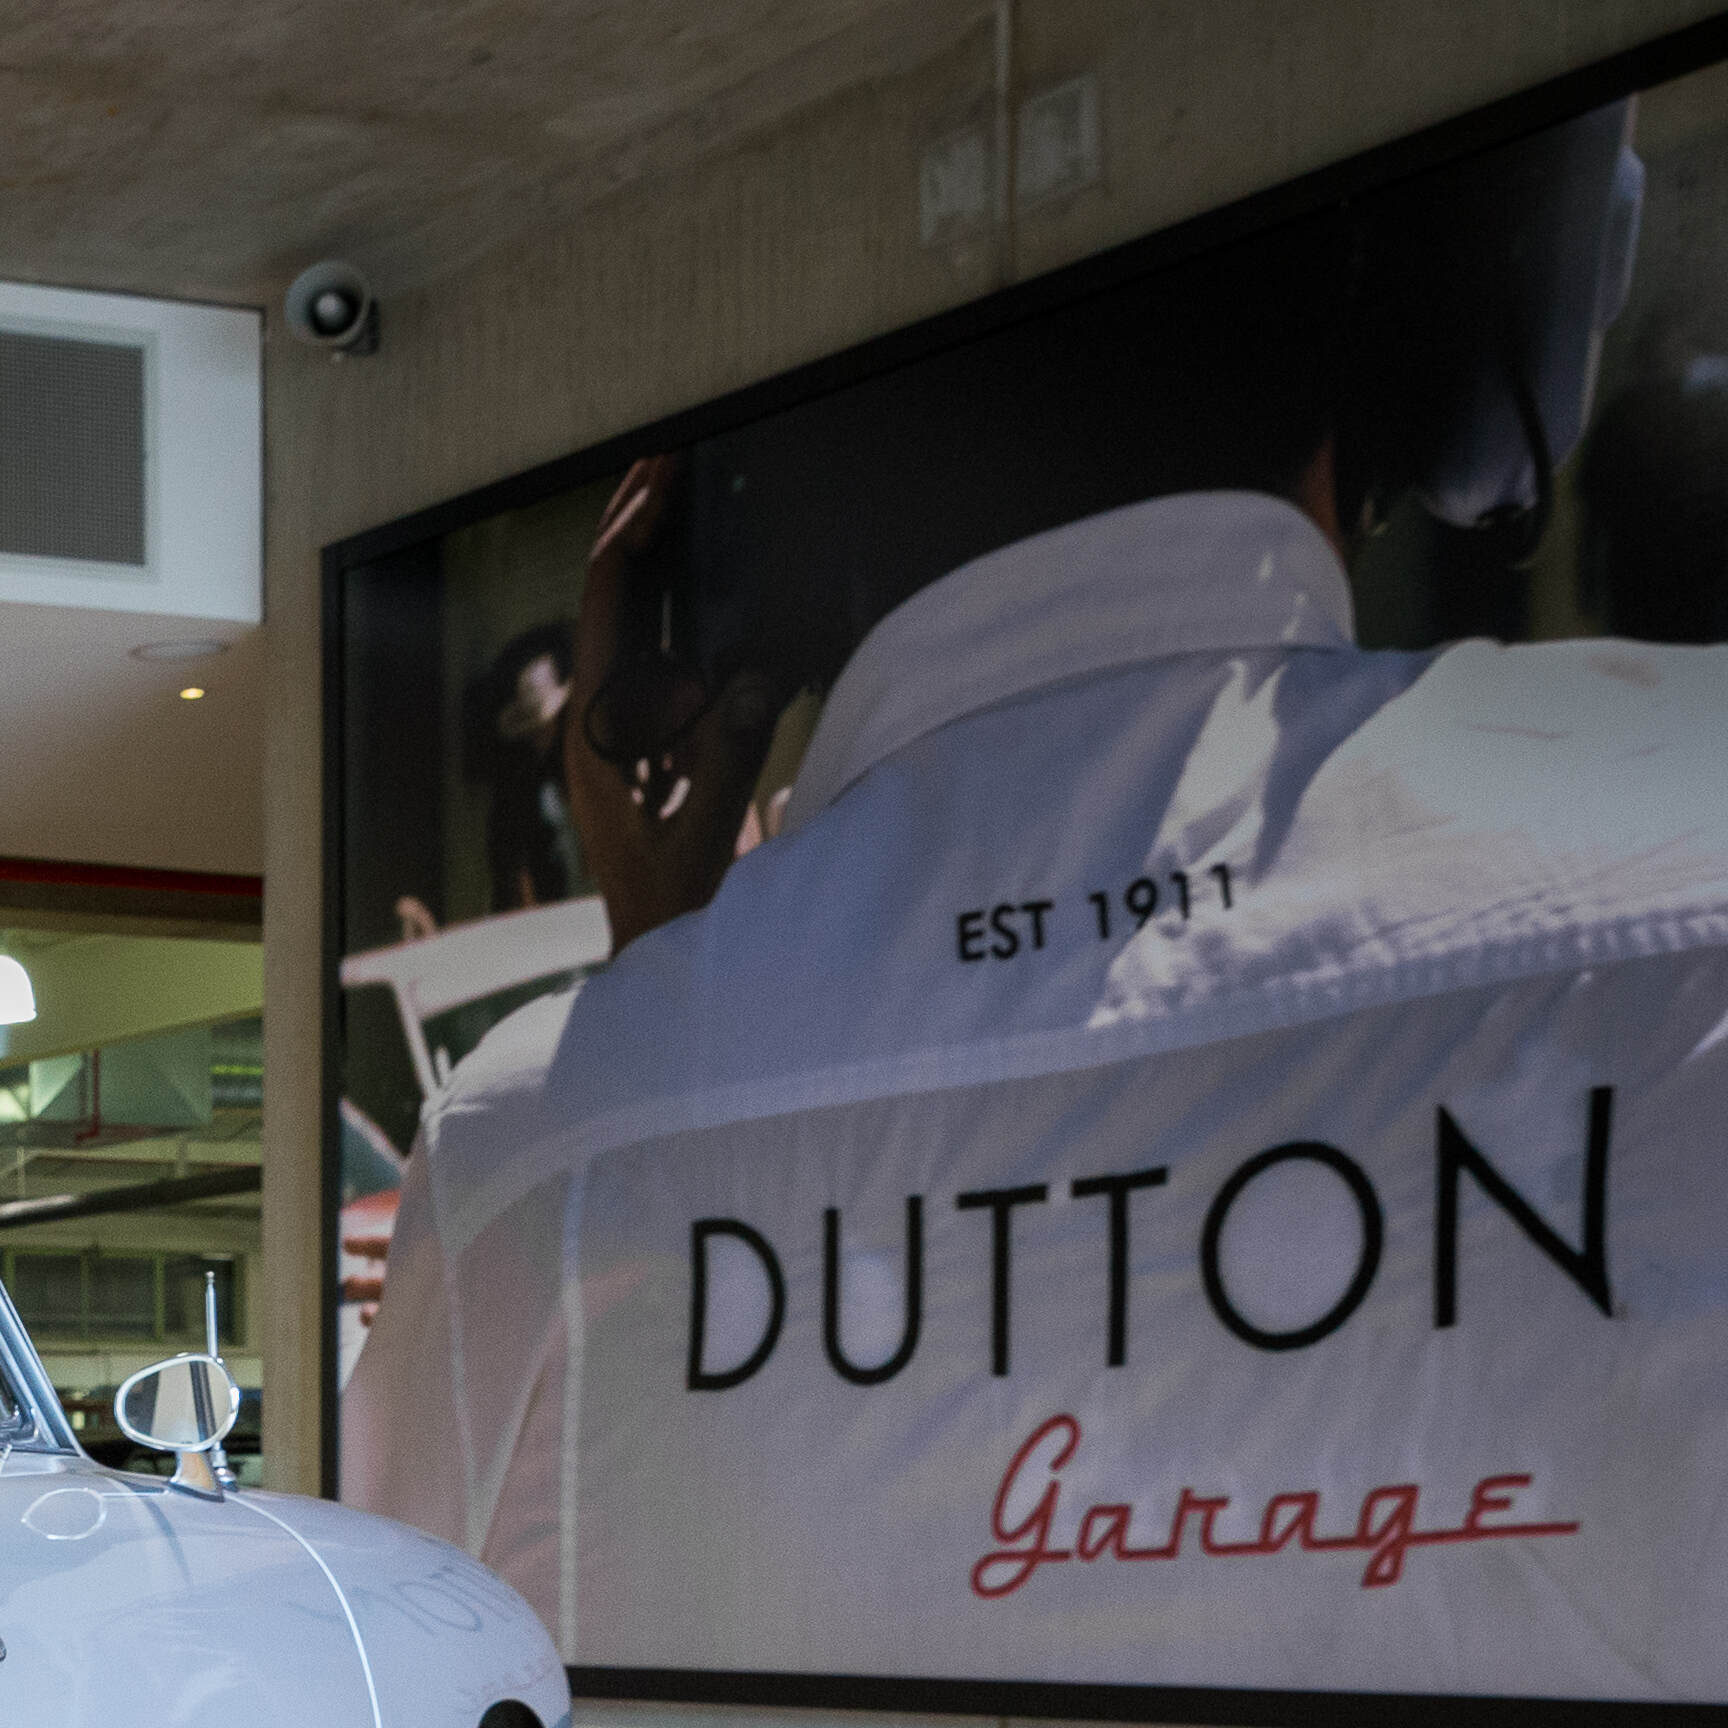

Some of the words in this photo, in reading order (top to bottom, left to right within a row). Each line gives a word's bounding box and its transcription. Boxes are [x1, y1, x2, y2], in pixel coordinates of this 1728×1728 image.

[955, 900, 1055, 963] EST
[1087, 863, 1238, 939] 1911
[686, 1085, 1617, 1392] DUTTON
[969, 1412, 1581, 1600] Garage
